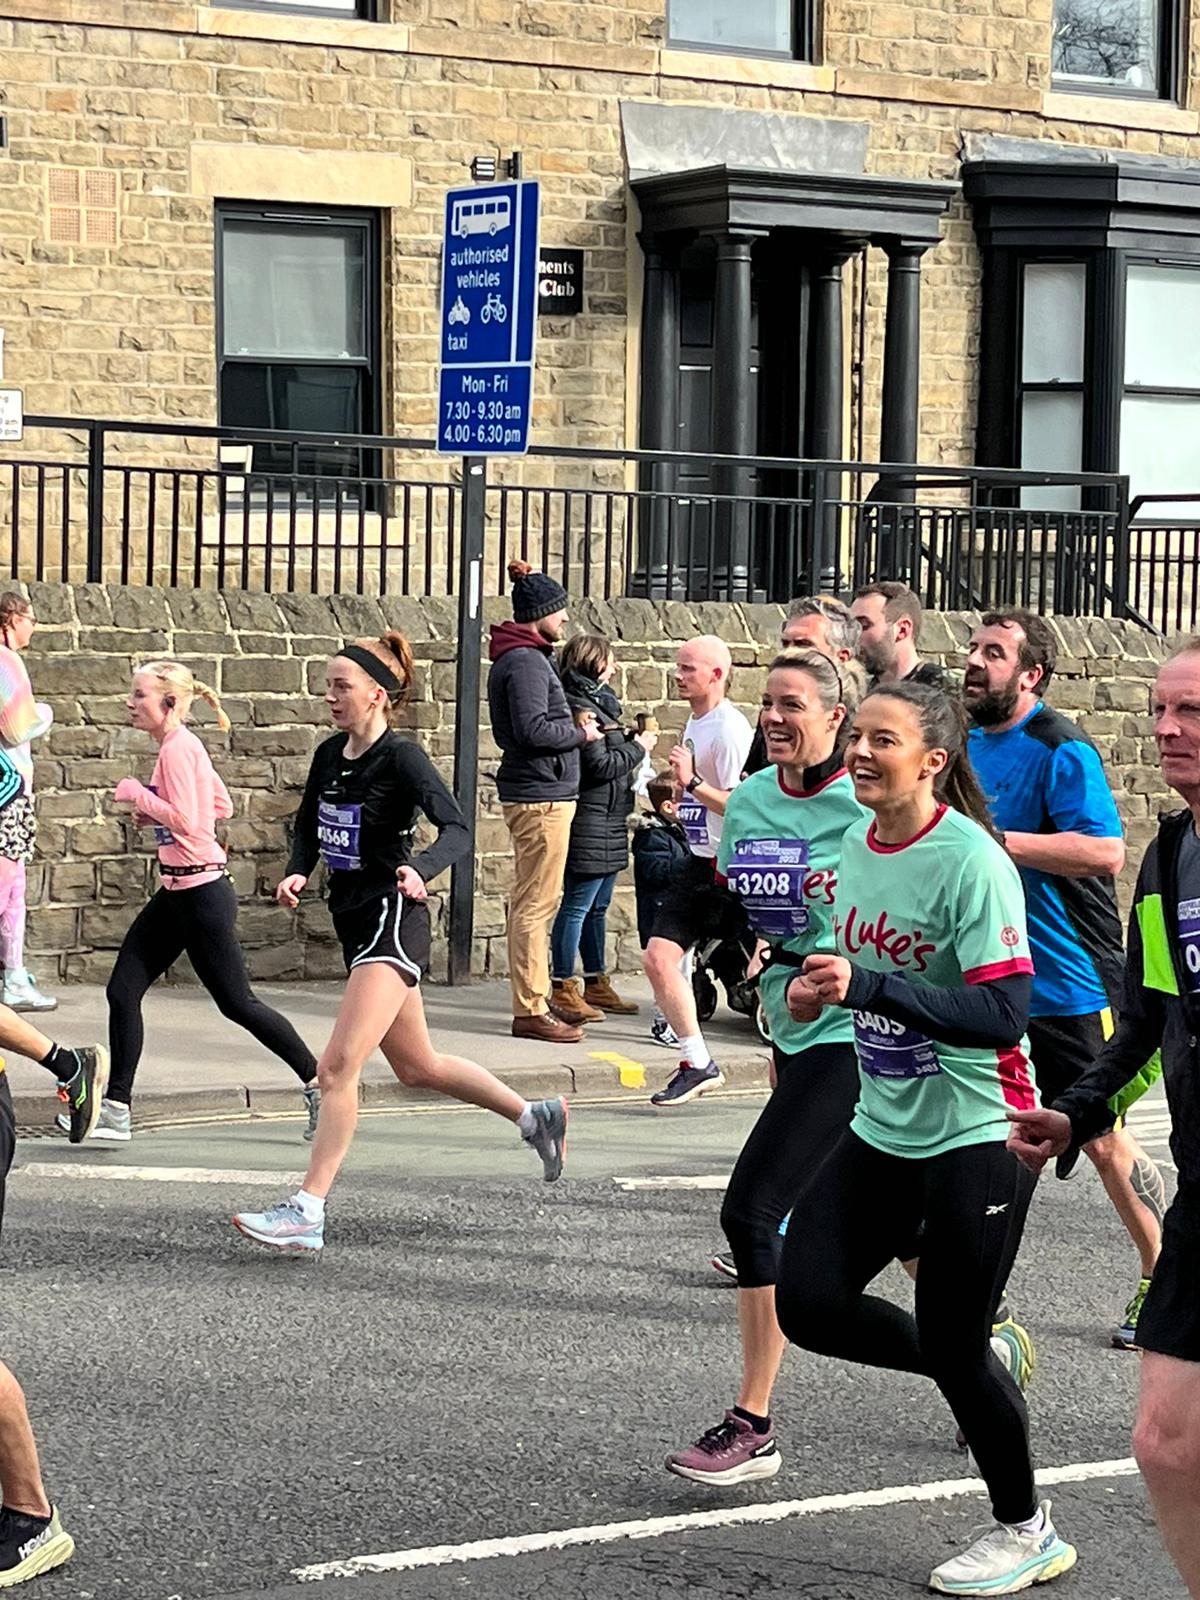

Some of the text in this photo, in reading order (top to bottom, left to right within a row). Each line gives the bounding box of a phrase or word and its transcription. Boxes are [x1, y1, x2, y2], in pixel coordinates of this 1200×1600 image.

[450, 243, 509, 267] authorised
[456, 268, 501, 289] vehicles
[540, 279, 575, 297] Club
[447, 332, 468, 351] taxi
[738, 872, 791, 896] 3208
